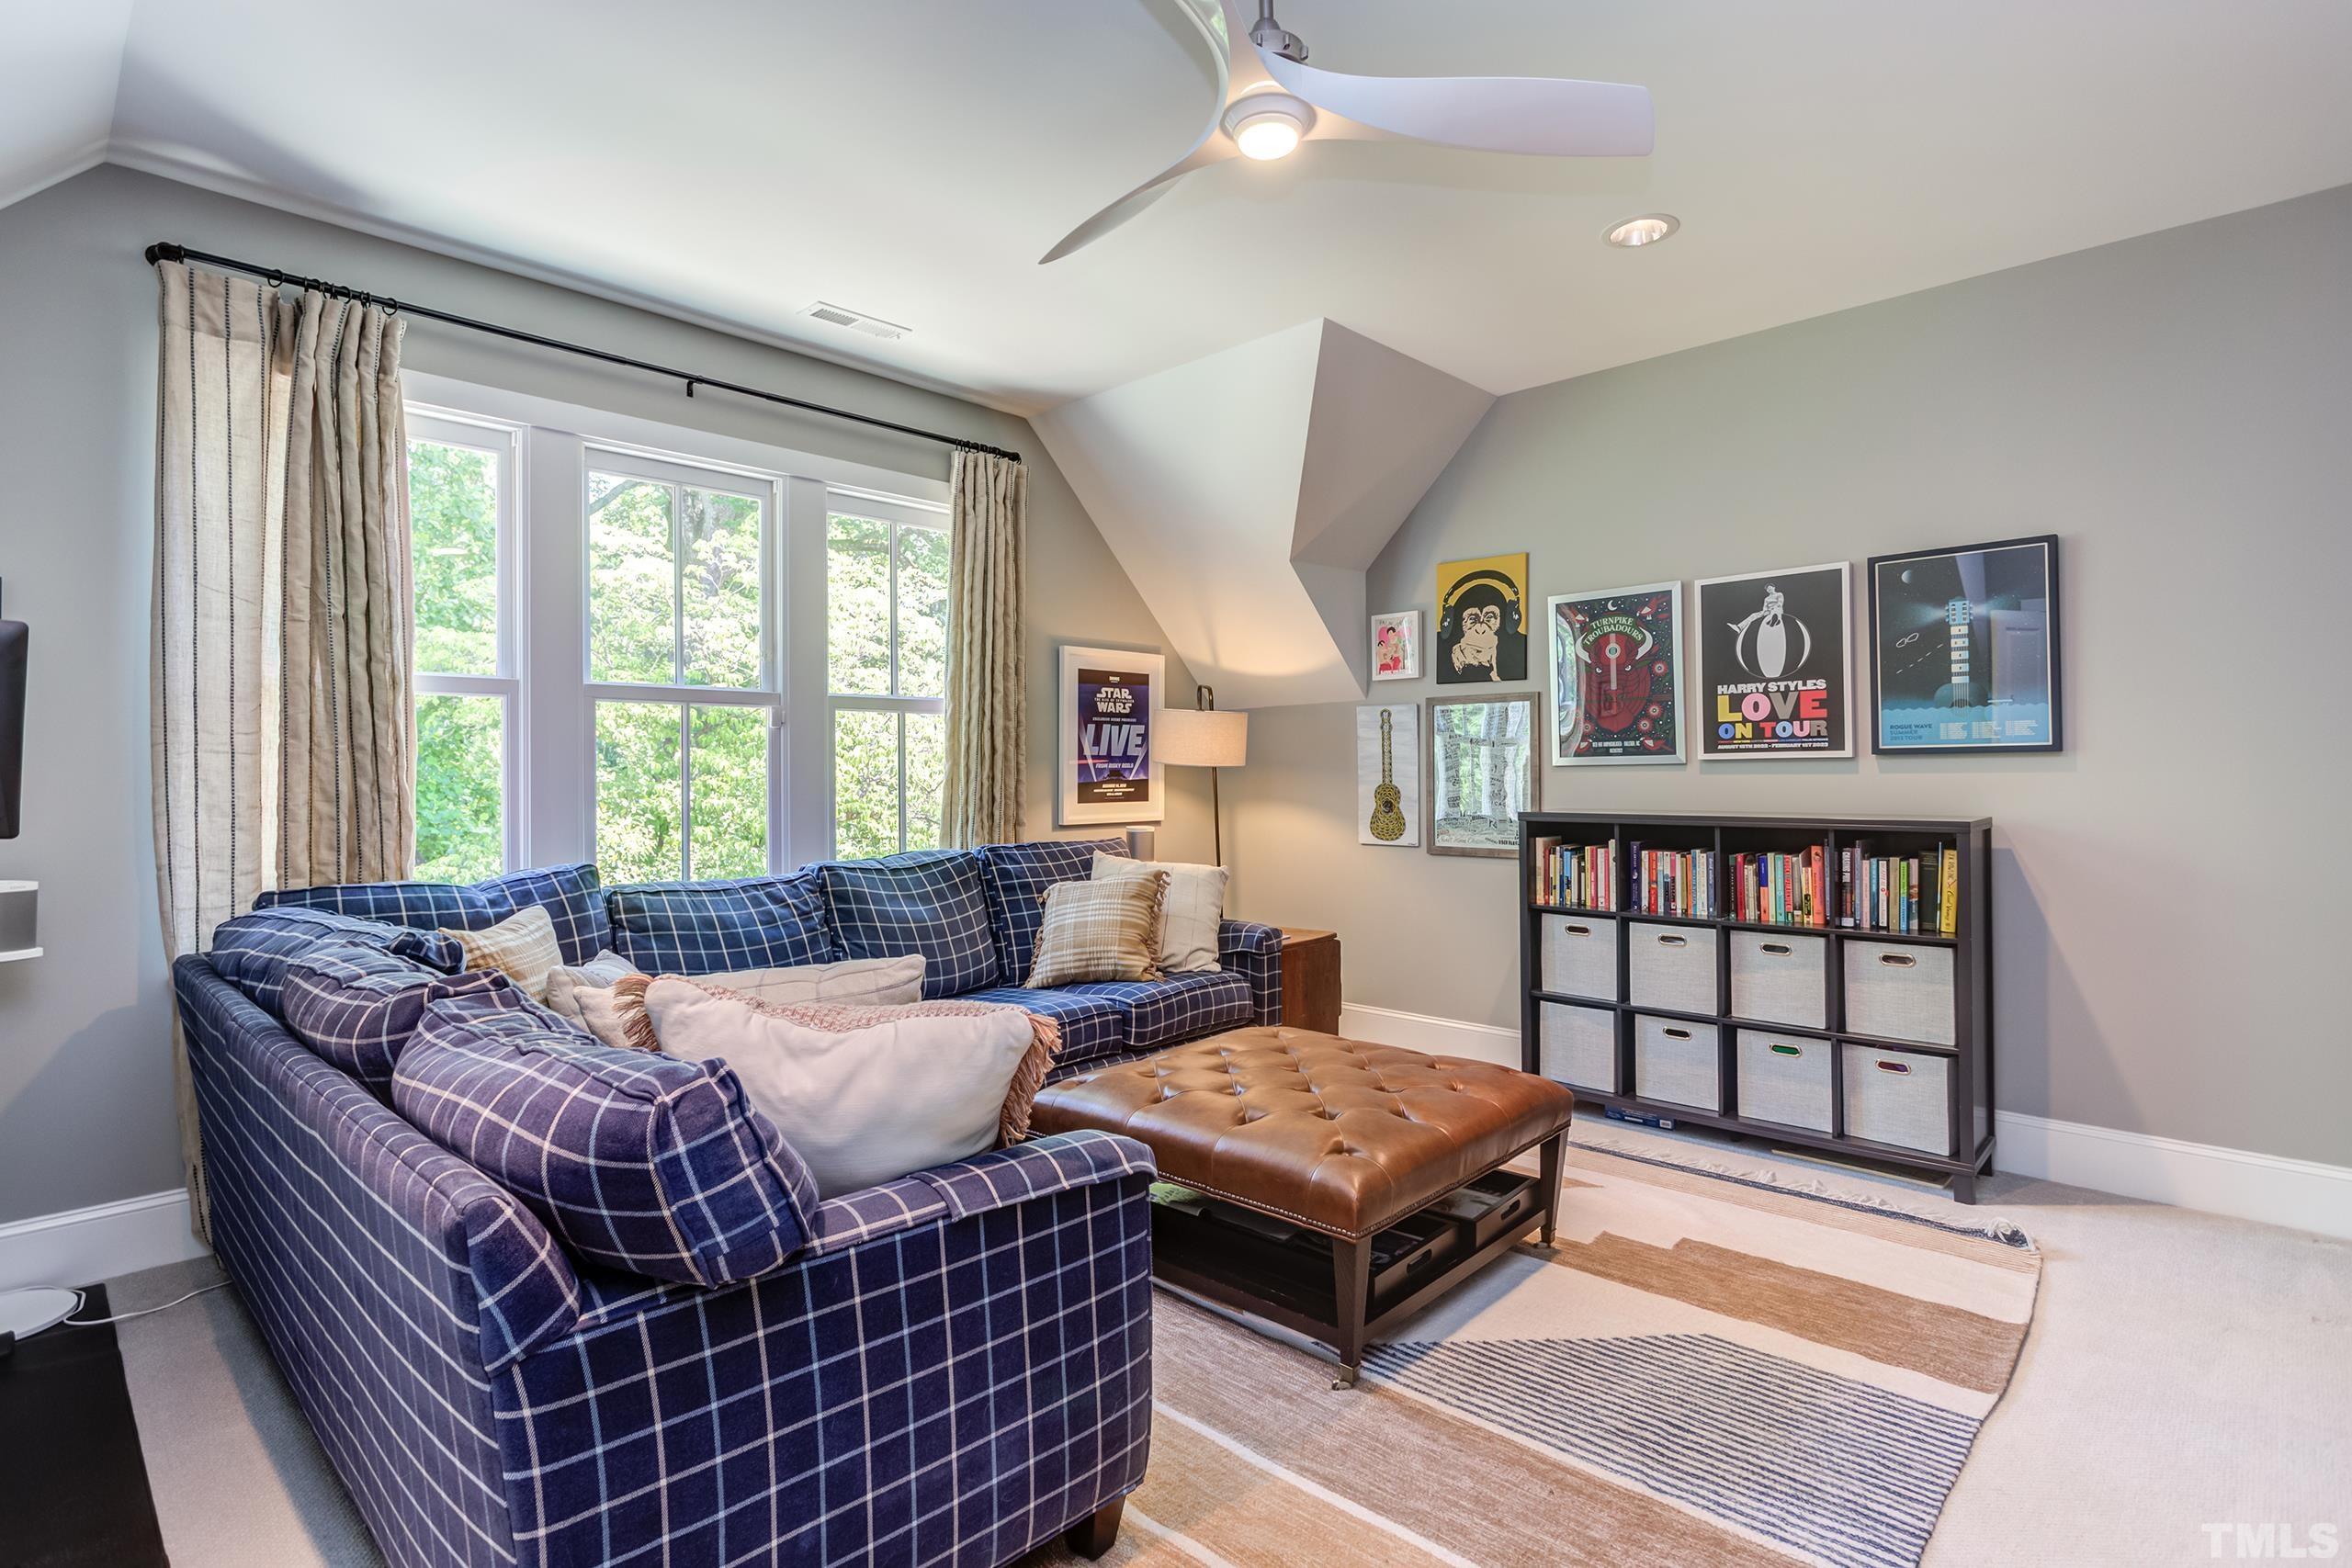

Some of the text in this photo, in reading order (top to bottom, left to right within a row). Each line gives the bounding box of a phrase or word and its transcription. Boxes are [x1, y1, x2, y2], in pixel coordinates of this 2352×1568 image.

[1590, 616, 1634, 628] TURNPIKE
[1584, 625, 1643, 646] TROUBADOURS
[1096, 687, 1132, 699] STAR
[1717, 679, 1826, 694] HARRY STYLES
[1097, 702, 1132, 714] WARS
[1717, 690, 1827, 722] LOVE
[1718, 720, 1828, 739] ON TOUR
[1083, 724, 1145, 757] LIVE
